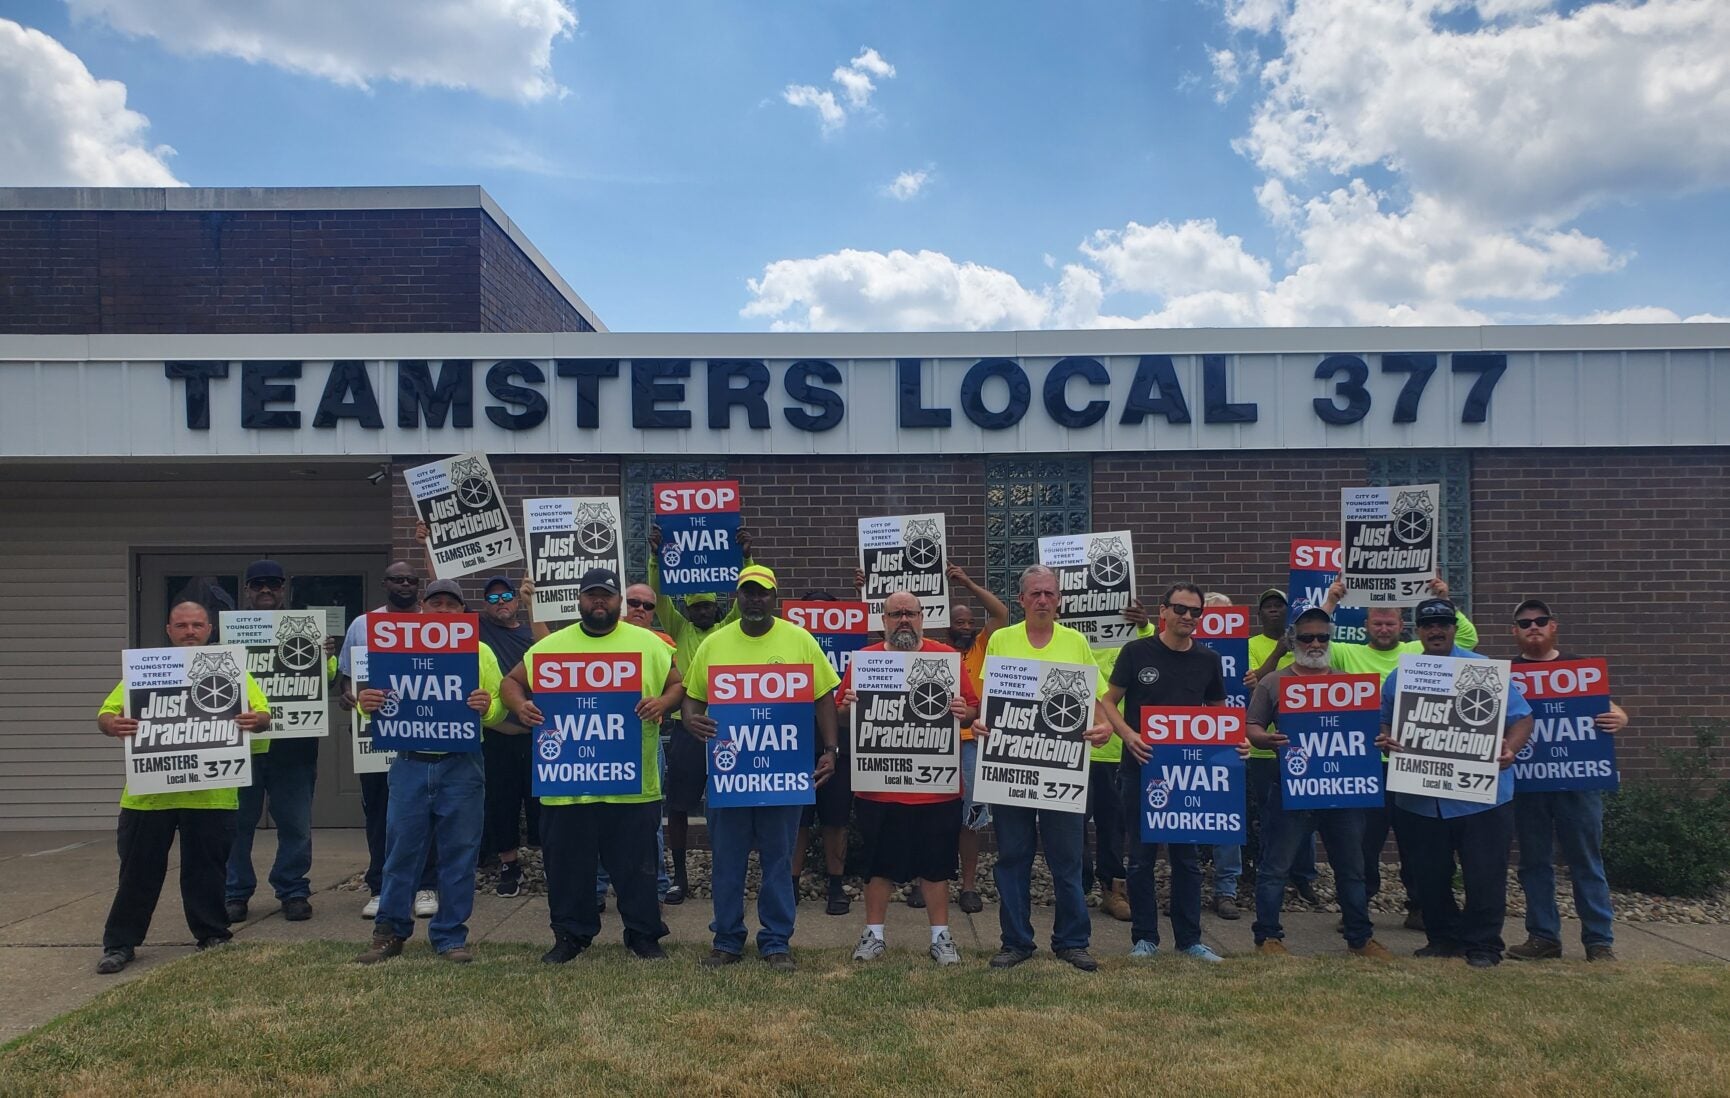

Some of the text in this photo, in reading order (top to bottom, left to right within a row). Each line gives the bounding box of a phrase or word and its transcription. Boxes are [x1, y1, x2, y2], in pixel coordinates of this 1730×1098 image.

[165, 353, 1507, 431] TEAMSTERS LOCAL 377
[411, 473, 446, 486] YOUNGSTOWN
[422, 482, 440, 490] STREET
[417, 486, 449, 498] DEPARTMENT
[660, 488, 734, 511] STOP
[429, 494, 460, 522] Just
[430, 508, 504, 545] Practicing
[689, 517, 706, 526] THE
[673, 530, 729, 551] WAR
[1353, 524, 1392, 546] Just
[435, 542, 482, 564] TEAMSTERS
[462, 537, 512, 568] Local No. 377
[539, 534, 575, 557] Just
[694, 555, 707, 564] ON
[872, 550, 904, 572] Just
[1295, 546, 1341, 567] ST
[1348, 546, 1430, 571] Practicing
[663, 566, 739, 584] WORKERS
[868, 571, 941, 595] Practicing
[1324, 575, 1337, 583] TH
[1346, 578, 1396, 590] TEAMSTERS
[536, 589, 580, 603] TEAMSTER
[1061, 588, 1129, 613] racticing
[561, 604, 576, 613] Local
[921, 605, 944, 617] 77
[788, 608, 863, 630] STOP
[1191, 613, 1244, 635] OP
[374, 621, 473, 649] STOP
[1090, 623, 1136, 643] No. 377
[246, 649, 275, 672] ust
[411, 658, 434, 670] THE
[826, 650, 851, 672] AR
[539, 661, 636, 688] STOP
[990, 672, 1038, 681] YOUNGSTOWN
[1404, 669, 1453, 677] YOUNGSTOWN
[1511, 668, 1601, 695] STOP
[390, 675, 462, 700] WAR
[714, 672, 808, 699] STOP
[989, 688, 1035, 698] DEPARTMENT
[1000, 681, 1026, 689] STREET
[1285, 681, 1375, 708] STOP
[1404, 684, 1450, 693] DEPARTMENT
[141, 690, 188, 719] Just
[417, 706, 433, 716] ON
[576, 697, 597, 709] THE
[865, 694, 906, 721] Just
[1408, 697, 1453, 724] Just
[1543, 702, 1566, 713] THE
[275, 722, 285, 731] No.
[288, 711, 323, 725] 377
[750, 708, 771, 719] THE
[994, 701, 1038, 730] Just
[1319, 716, 1339, 727] THE
[134, 716, 238, 747] Practicing
[377, 720, 475, 739] WORKERS
[554, 714, 625, 740] WAR
[1148, 715, 1240, 740] STOP
[1530, 716, 1596, 743] WAR
[729, 725, 798, 751] WAR
[859, 722, 952, 753] Practicing
[1299, 731, 1366, 757] WAR
[1400, 722, 1495, 760] Practicing
[579, 746, 595, 758] ON
[986, 728, 1083, 768] Practicing
[1182, 749, 1202, 760] THE
[1551, 747, 1568, 757] ON
[132, 754, 198, 773] TEAMSTERS
[167, 758, 245, 784] Local No. 377
[538, 762, 635, 782] WORKERS
[754, 756, 769, 768] ON
[857, 757, 912, 772] TEAMSTERS
[1323, 762, 1339, 773] ON
[1395, 757, 1454, 777] TEAMSTERS
[1513, 760, 1612, 779] WORKERS
[714, 772, 809, 793] WORKERS
[885, 766, 957, 785] Local No. 377
[982, 766, 1039, 785] TEAMSTERS
[1162, 766, 1229, 792] WAR
[1422, 772, 1495, 791] Local No. 377
[1009, 781, 1084, 800] Local No. 377
[1287, 777, 1379, 796] WORKERS
[1185, 796, 1201, 807] ON
[1147, 812, 1241, 830] WORKERS
